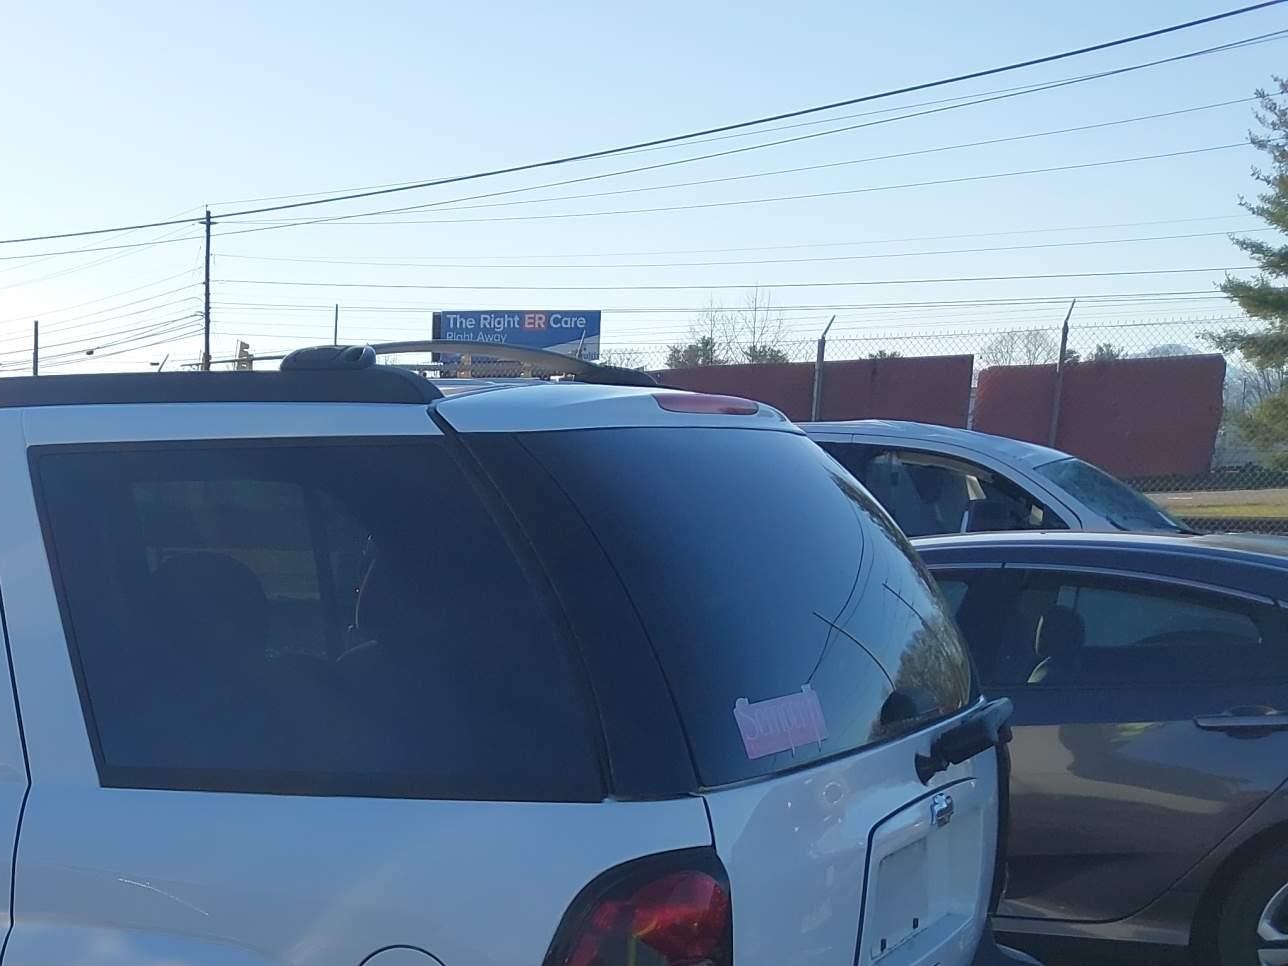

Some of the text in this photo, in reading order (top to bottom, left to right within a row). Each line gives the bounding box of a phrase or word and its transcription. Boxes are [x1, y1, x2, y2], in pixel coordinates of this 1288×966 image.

[446, 314, 586, 332] The Right ER Care
[446, 332, 508, 344] Right Away
